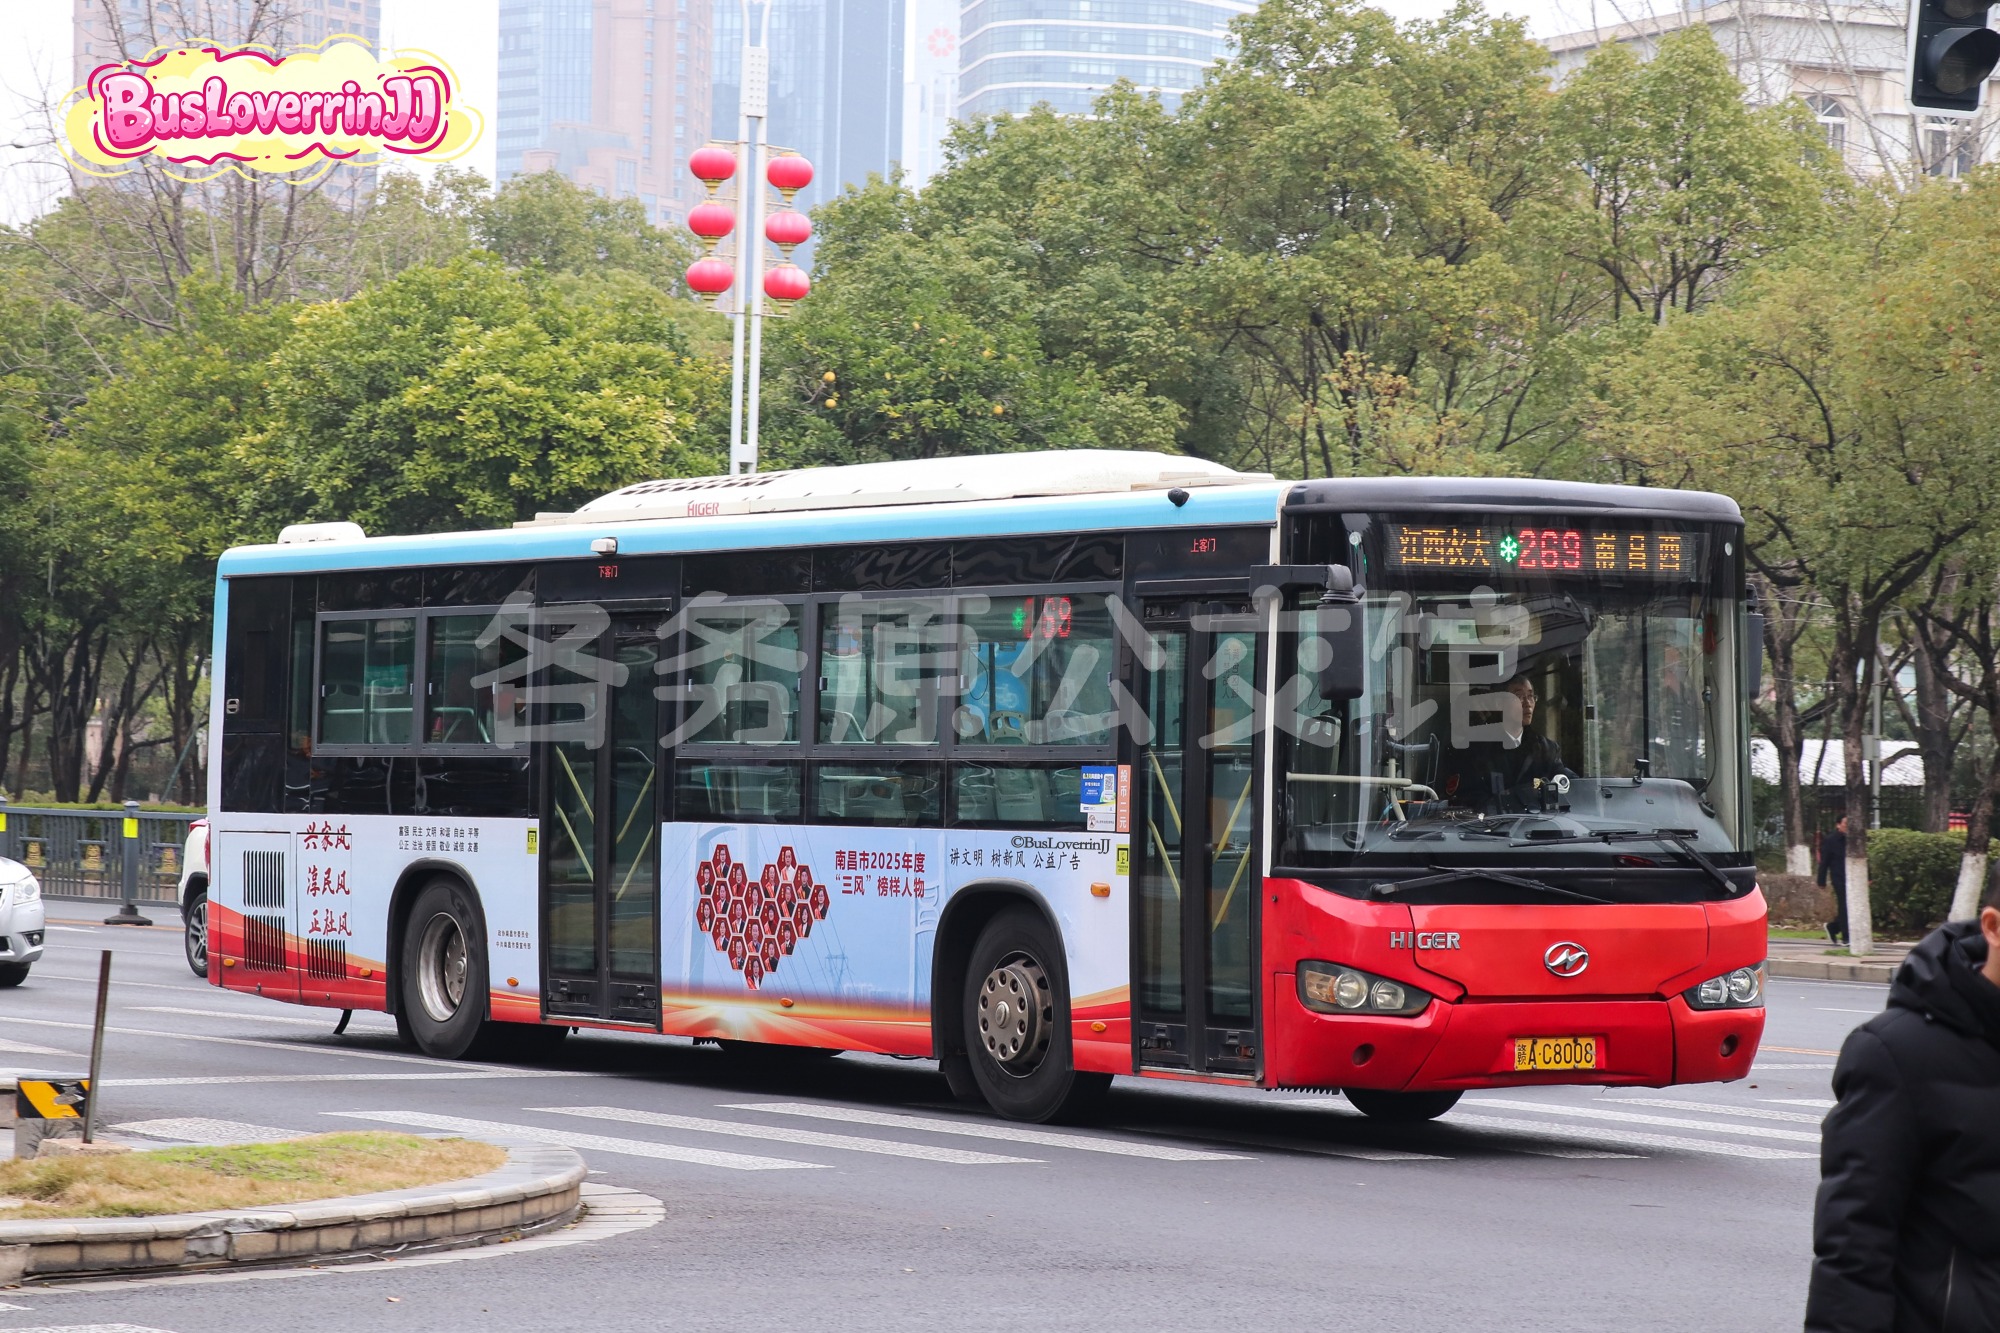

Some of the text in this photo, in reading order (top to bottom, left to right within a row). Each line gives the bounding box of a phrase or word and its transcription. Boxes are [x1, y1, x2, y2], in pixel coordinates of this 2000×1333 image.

[687, 502, 720, 517] HIGER
[1190, 538, 1216, 553] 上客门
[1518, 530, 1581, 568] 269
[598, 565, 618, 578] 下客门
[1119, 769, 1128, 829] 投币二元
[303, 821, 351, 852] 兴家风
[835, 850, 926, 873] 南昌市2025年度
[949, 848, 1081, 871] 讲文明 树新风 公益广告
[1390, 931, 1461, 950] HIGER
